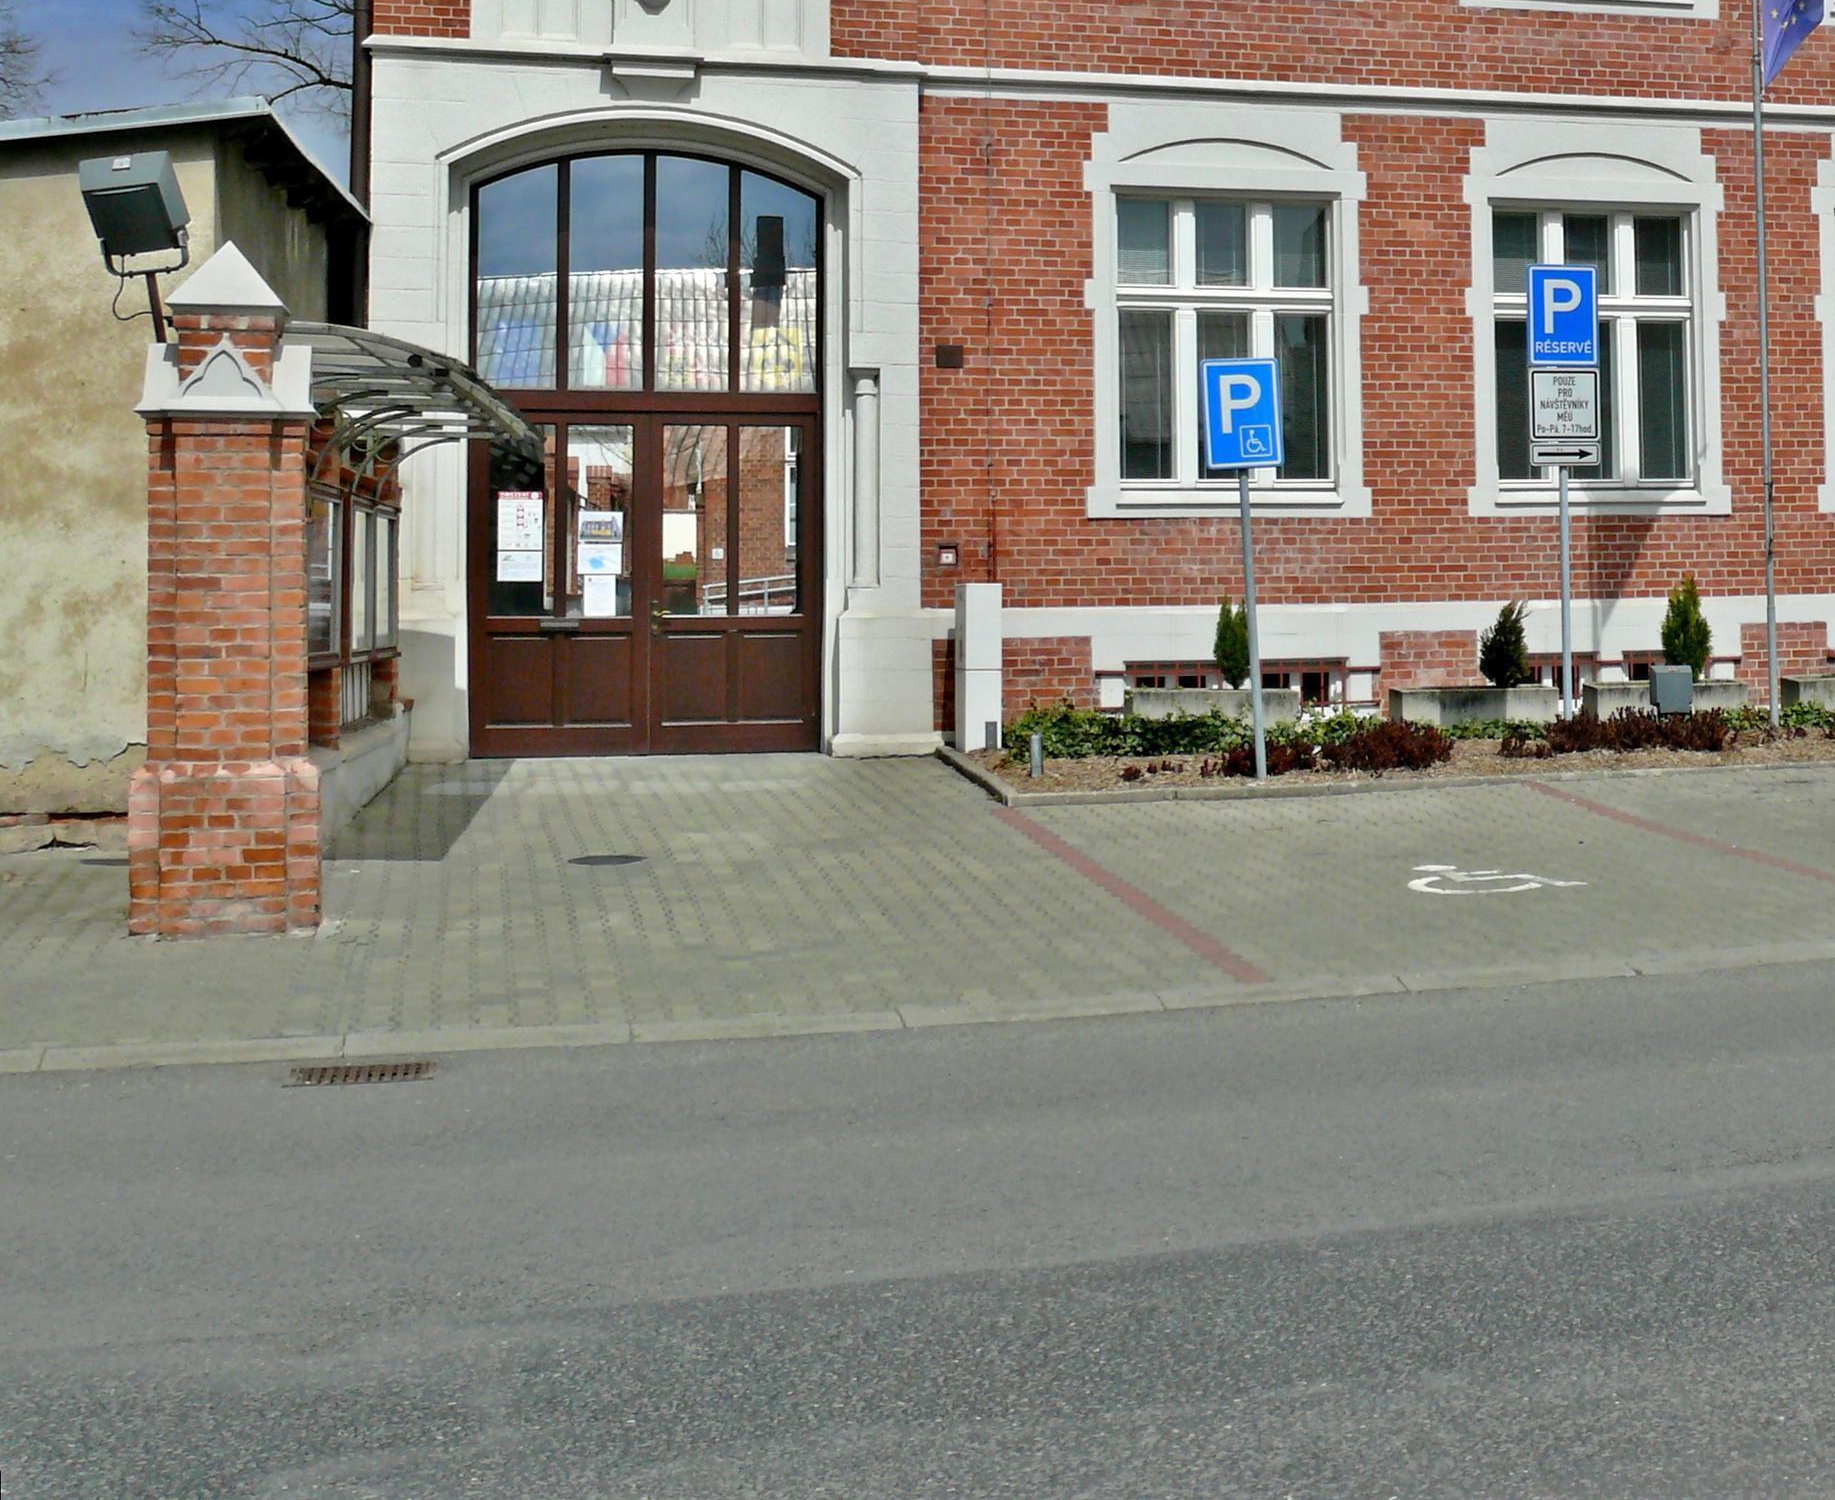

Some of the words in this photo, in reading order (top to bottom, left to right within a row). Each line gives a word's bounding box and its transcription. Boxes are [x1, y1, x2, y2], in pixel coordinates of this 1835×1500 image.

[1543, 279, 1582, 334] P
[1535, 338, 1592, 354] RÉSERVÉ
[1552, 376, 1576, 386] POUZE
[1557, 388, 1573, 398] PRO
[1219, 374, 1261, 434] P
[1540, 397, 1589, 410] NÁVŠTĚVNÍKY
